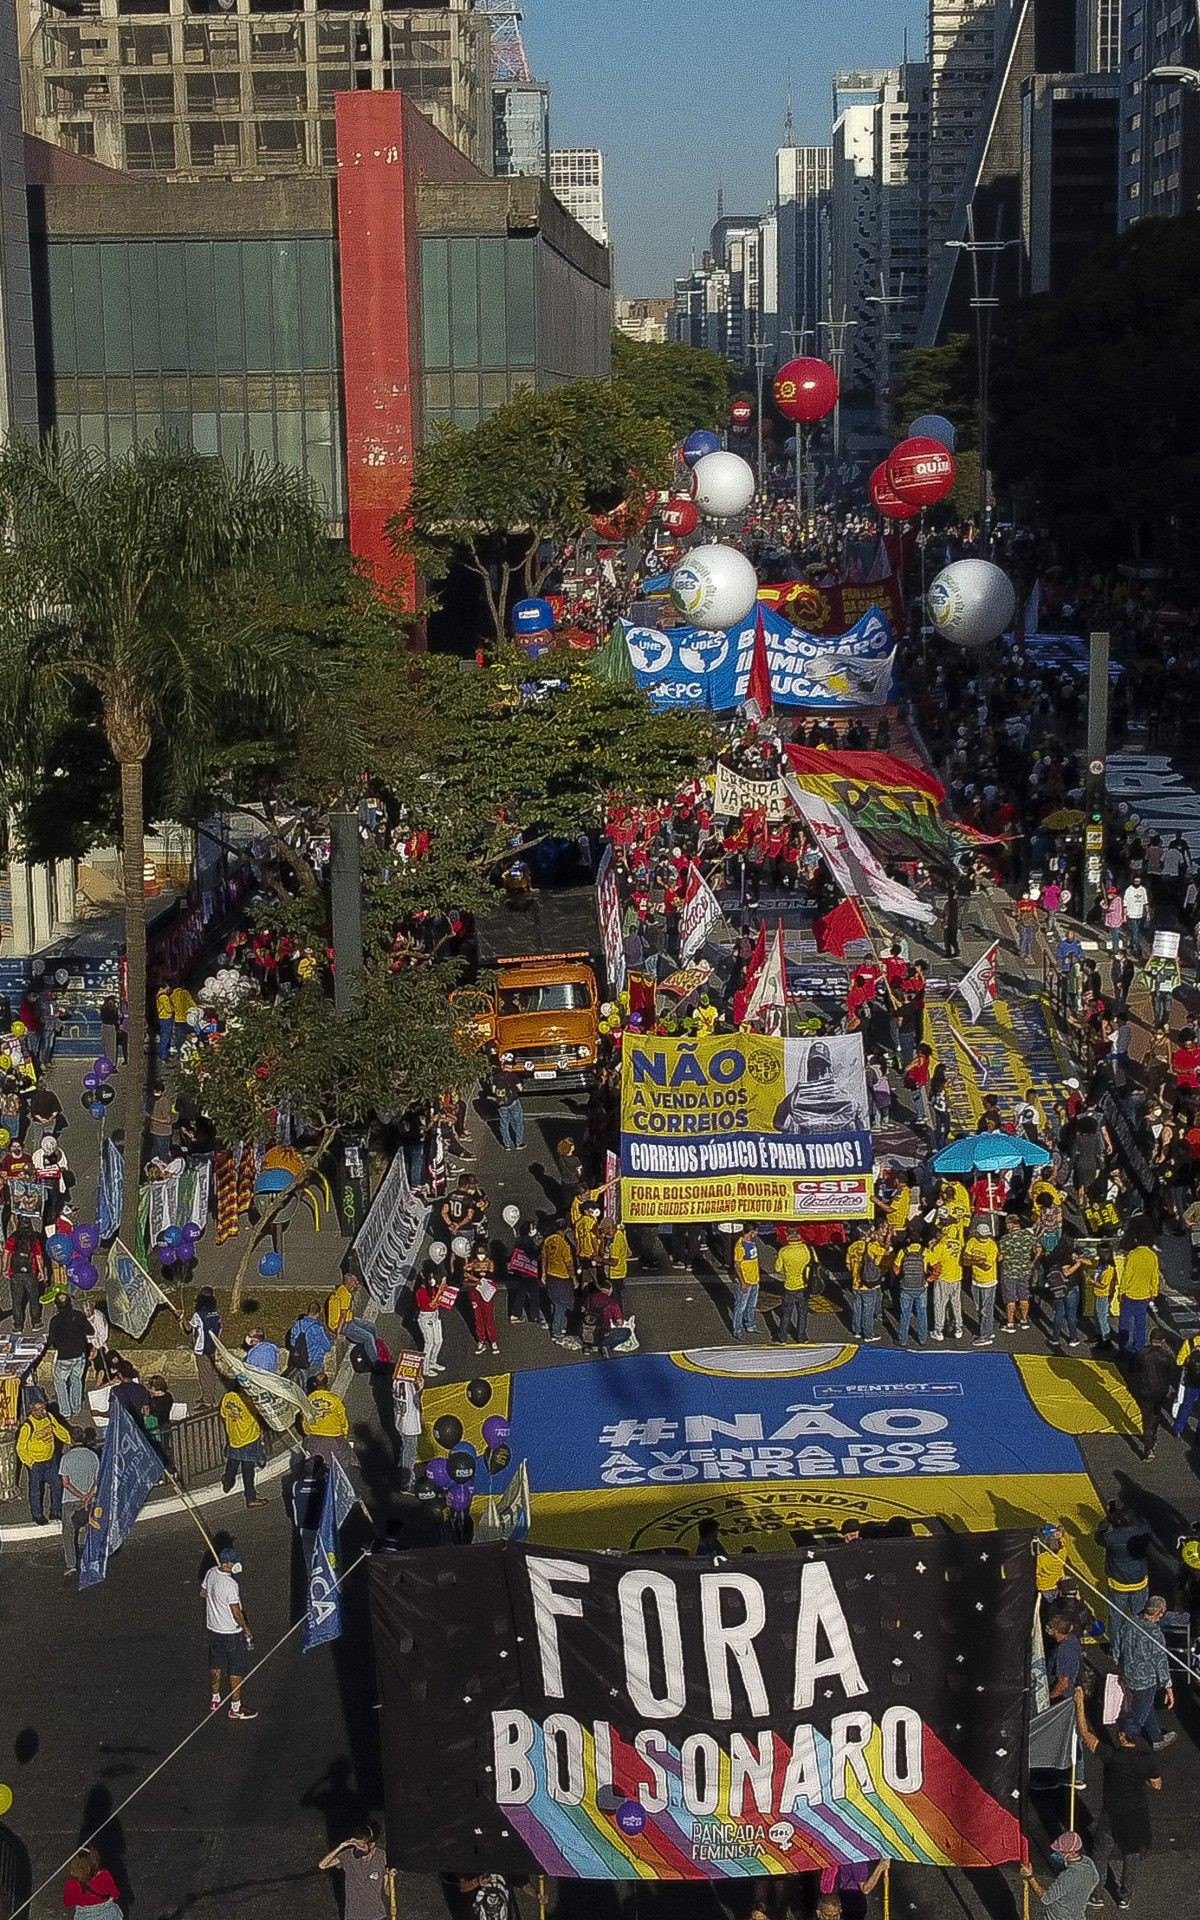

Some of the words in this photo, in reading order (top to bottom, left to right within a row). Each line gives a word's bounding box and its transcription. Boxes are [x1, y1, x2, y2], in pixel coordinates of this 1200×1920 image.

[632, 1042, 747, 1087] NÃO
[650, 1090, 711, 1109] VENDA
[714, 1088, 749, 1108] DOS
[633, 1108, 750, 1133] CORREIOS
[631, 1143, 699, 1172] CORREIOS
[699, 1138, 758, 1171] PÚBLICO
[759, 1137, 769, 1168] É
[768, 1141, 806, 1170] PARA
[806, 1139, 855, 1169] TODOS
[855, 1139, 863, 1167] !
[631, 1186, 660, 1200] FORA
[663, 1183, 734, 1200] BOLSONARO,
[737, 1181, 790, 1197] MOURÃO,
[798, 1181, 860, 1192] CSP
[630, 1202, 655, 1216] PAULO
[657, 1201, 688, 1216] GUEDES
[690, 1201, 696, 1215] E
[697, 1199, 736, 1215] FLORIANO
[738, 1198, 772, 1213] PEIXOTO
[599, 1403, 949, 1447] #NÃO
[651, 1445, 834, 1464] VENDA
[847, 1441, 957, 1457] DOS
[601, 1454, 961, 1484] CORREIOS
[752, 1494, 869, 1511] VENDA
[525, 1554, 870, 1721] FORA
[492, 1706, 925, 1817] BOLSONARO
[692, 1821, 766, 1844] BANCADA
[692, 1844, 766, 1861] FEMINISTA
